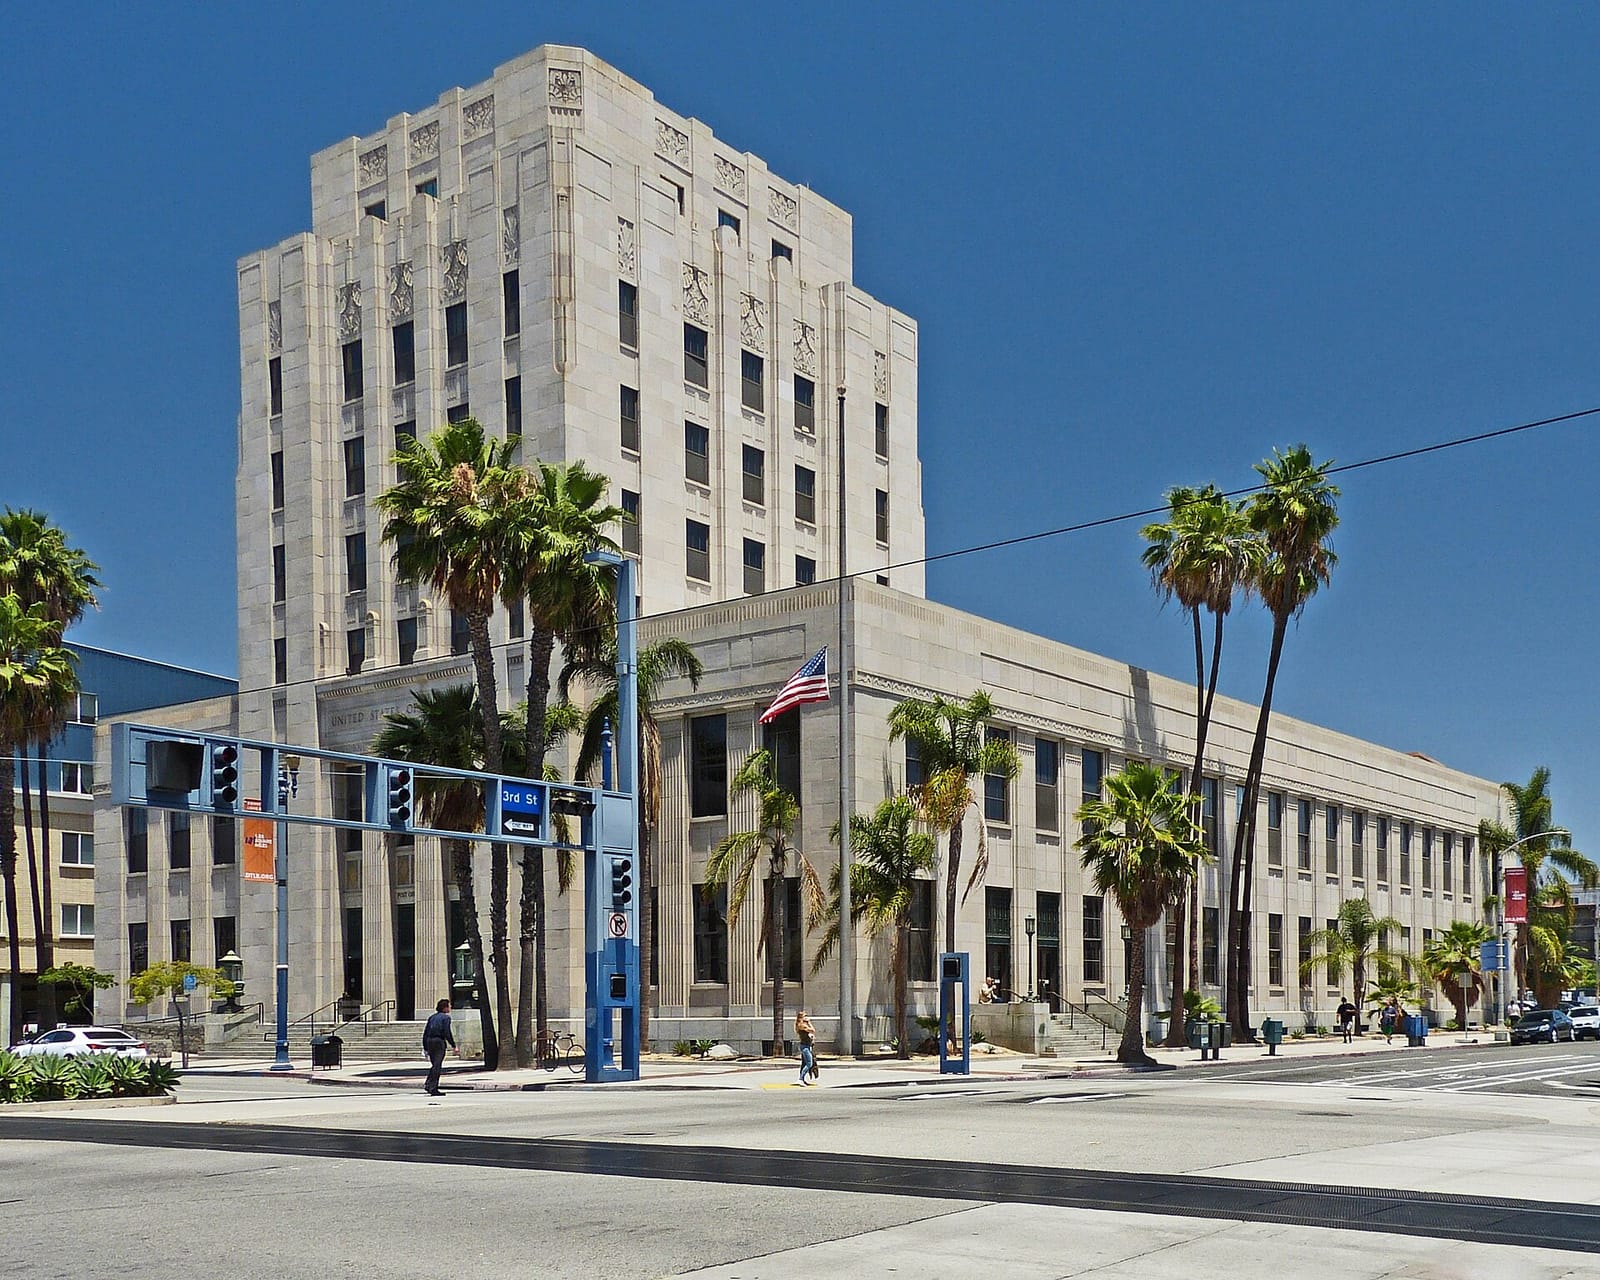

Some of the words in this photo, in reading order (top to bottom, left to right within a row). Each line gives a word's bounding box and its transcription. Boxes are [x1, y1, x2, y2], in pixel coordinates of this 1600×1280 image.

[331, 712, 364, 727] UNITED
[503, 790, 520, 803] 3rd
[526, 793, 538, 805] St
